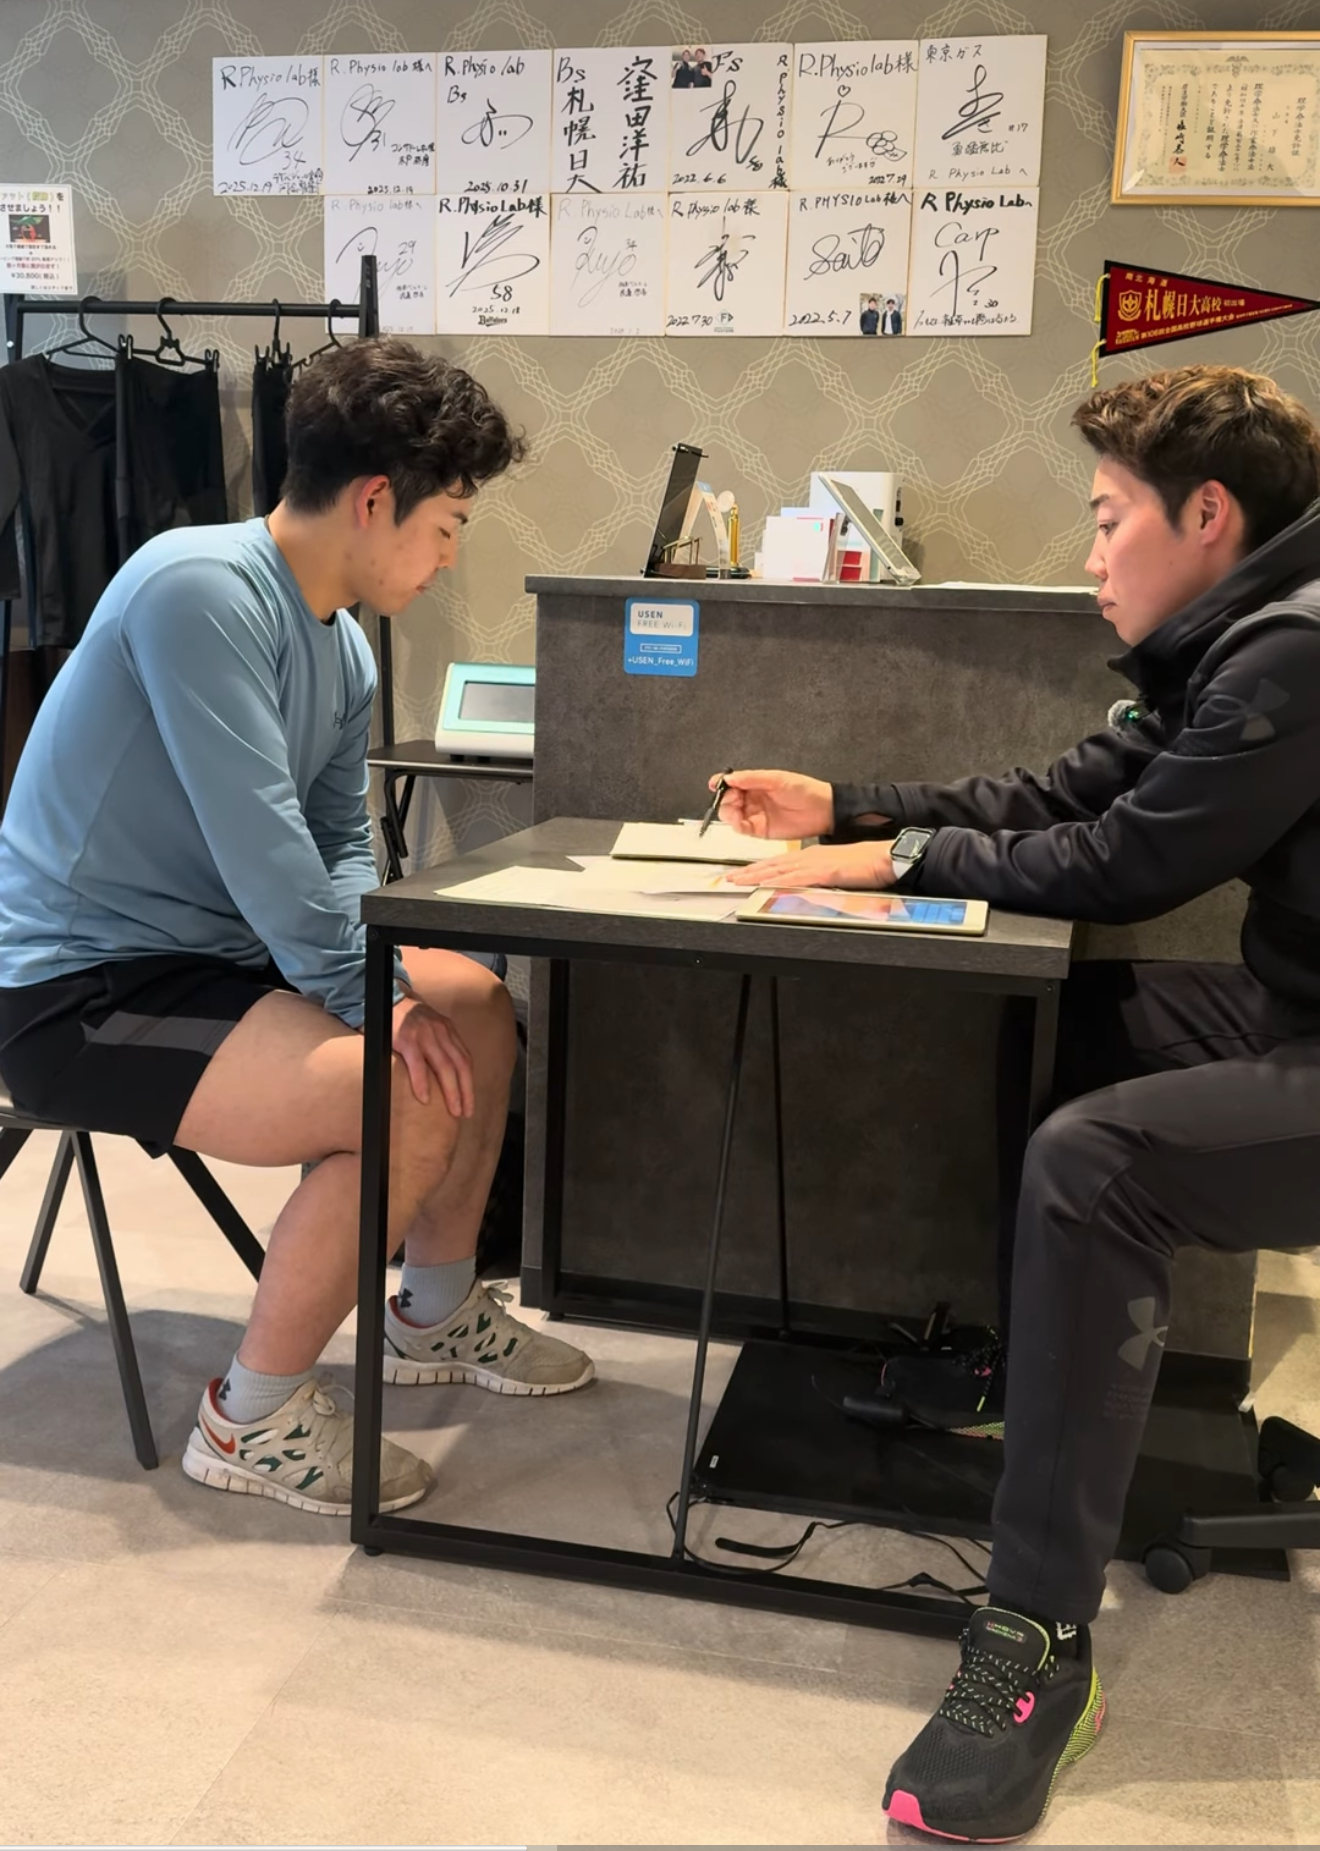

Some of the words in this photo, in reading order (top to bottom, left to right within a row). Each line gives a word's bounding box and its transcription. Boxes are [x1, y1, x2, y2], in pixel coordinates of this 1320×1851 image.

[926, 43, 982, 64] 東京ガス
[557, 57, 586, 83] Bs
[447, 85, 467, 104] Bs
[612, 56, 658, 190] 窪田洋祐
[561, 86, 602, 194] 札幌日大
[282, 150, 307, 170] 34
[948, 166, 984, 182] Physio
[991, 164, 1011, 175] Lab
[920, 192, 938, 212] R
[946, 191, 995, 215] Physio
[398, 240, 417, 256] 29
[935, 221, 1000, 262] Carp
[490, 285, 513, 302] 58
[1144, 288, 1222, 323] 札幌日大高校
[637, 610, 663, 619] USEN
[637, 620, 660, 629] FREE
